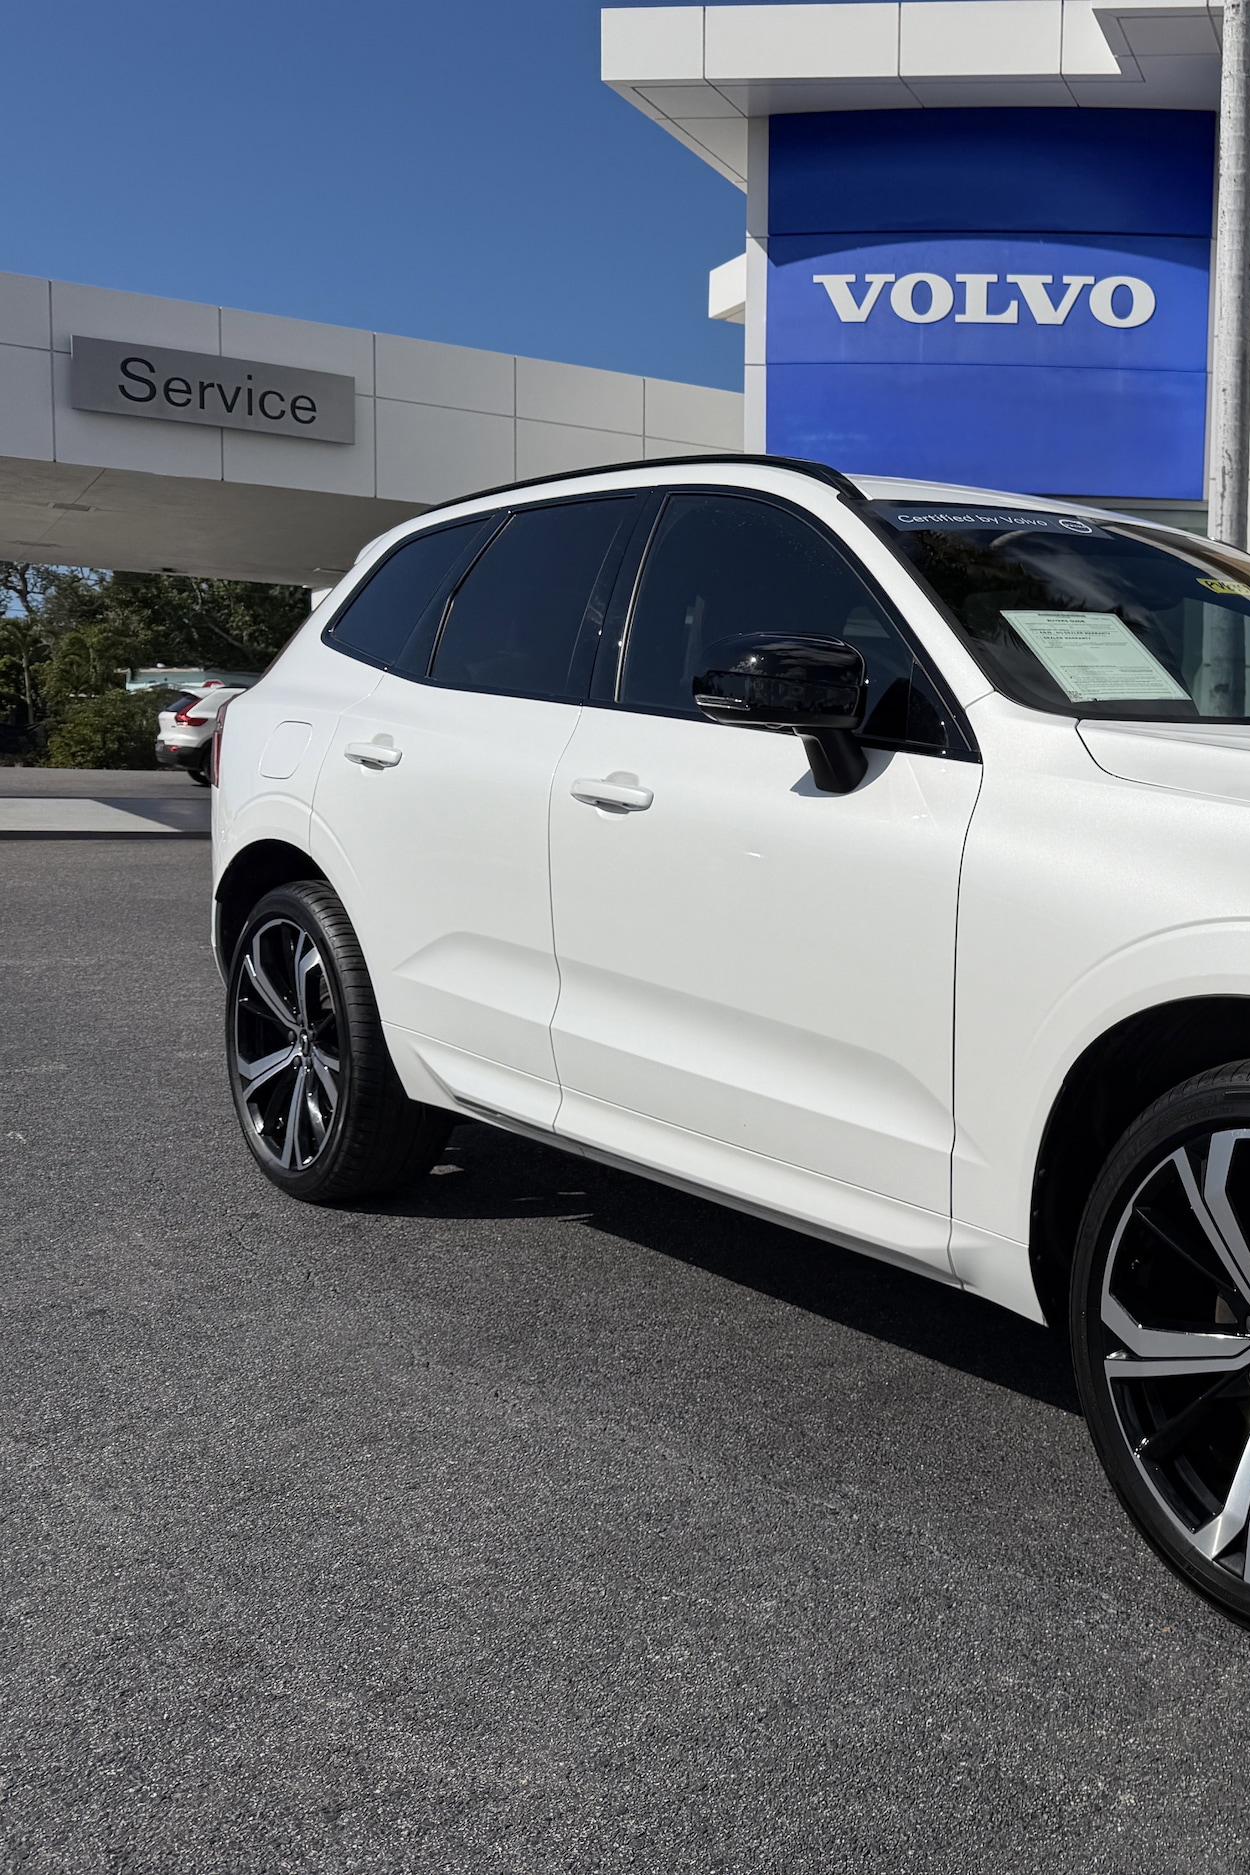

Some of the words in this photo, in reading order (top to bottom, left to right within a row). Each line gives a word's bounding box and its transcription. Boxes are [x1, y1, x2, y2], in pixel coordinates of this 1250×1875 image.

[812, 272, 1156, 328] VOLVO
[118, 356, 318, 425] Service
[897, 513, 973, 525] Certified
[976, 514, 1000, 526] by
[999, 515, 1049, 527] Volvo
